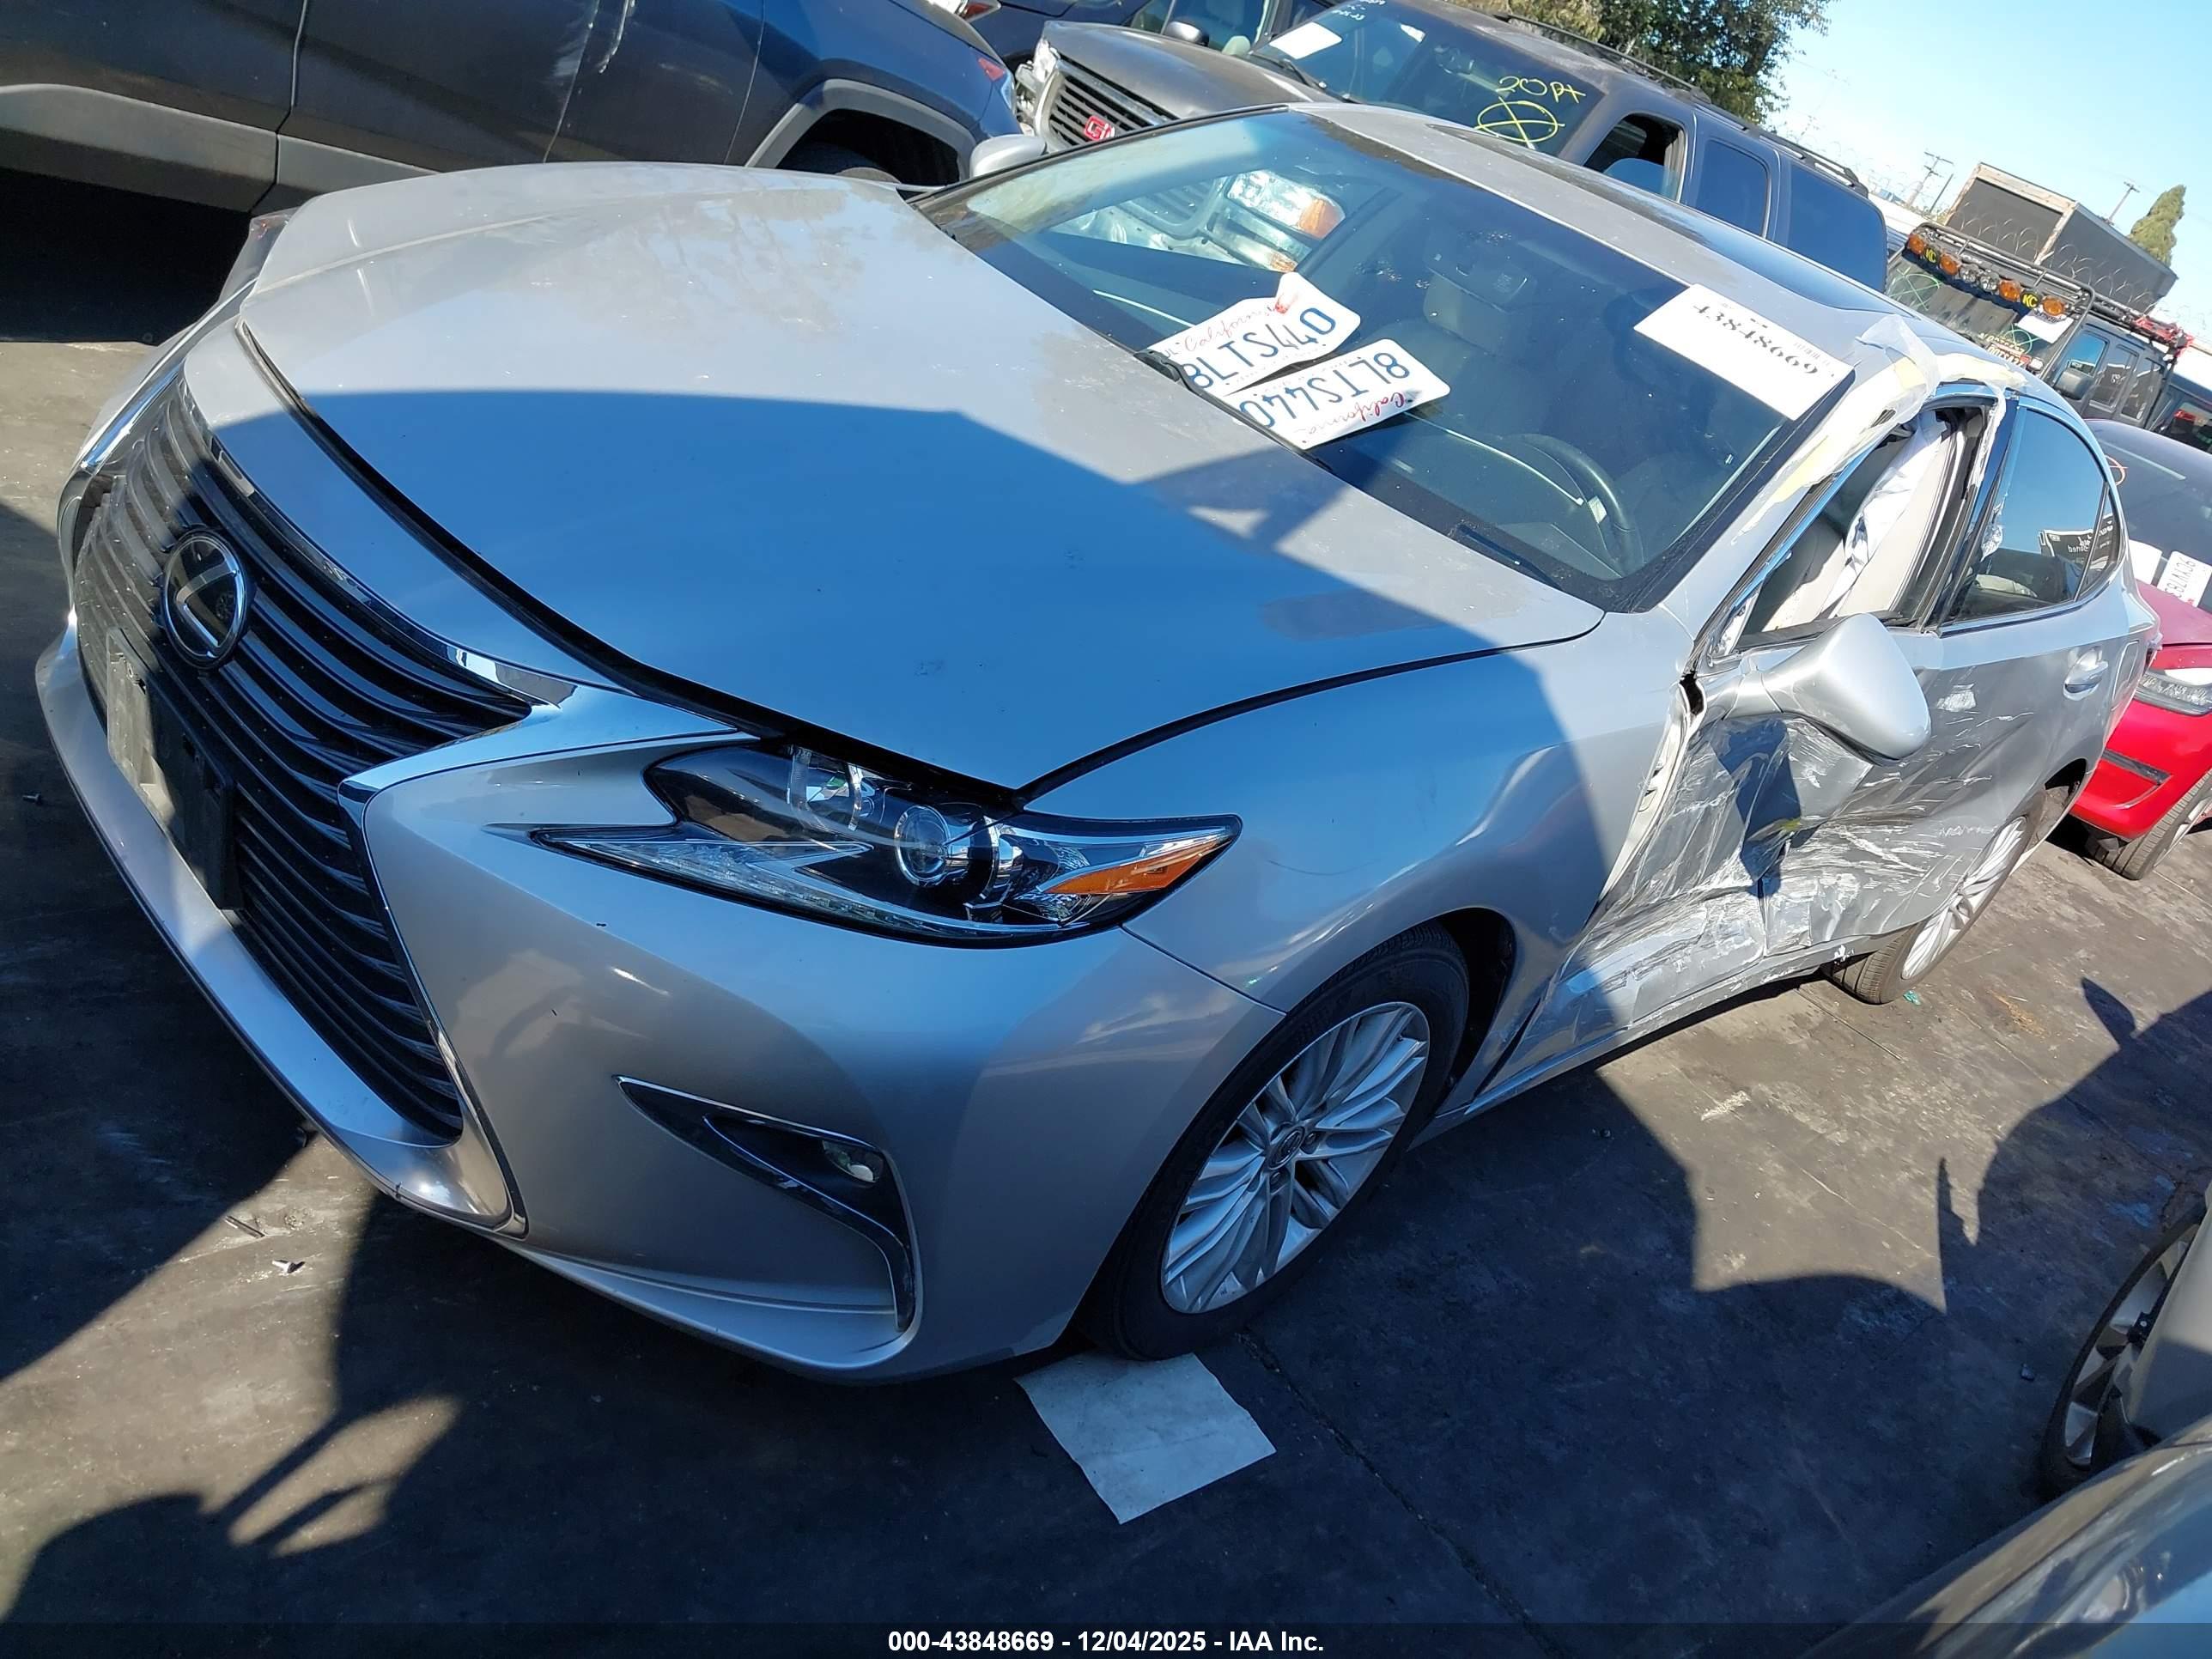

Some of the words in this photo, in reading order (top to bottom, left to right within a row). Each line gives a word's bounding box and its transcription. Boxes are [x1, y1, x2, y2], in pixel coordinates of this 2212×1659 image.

[1925, 248, 1937, 264] KC
[2022, 294, 2039, 308] KC
[1182, 307, 1337, 389] 8LTS440
[1692, 304, 1818, 374] 43848669
[1238, 352, 1411, 428] 8LTS440
[1293, 392, 1407, 435] California
